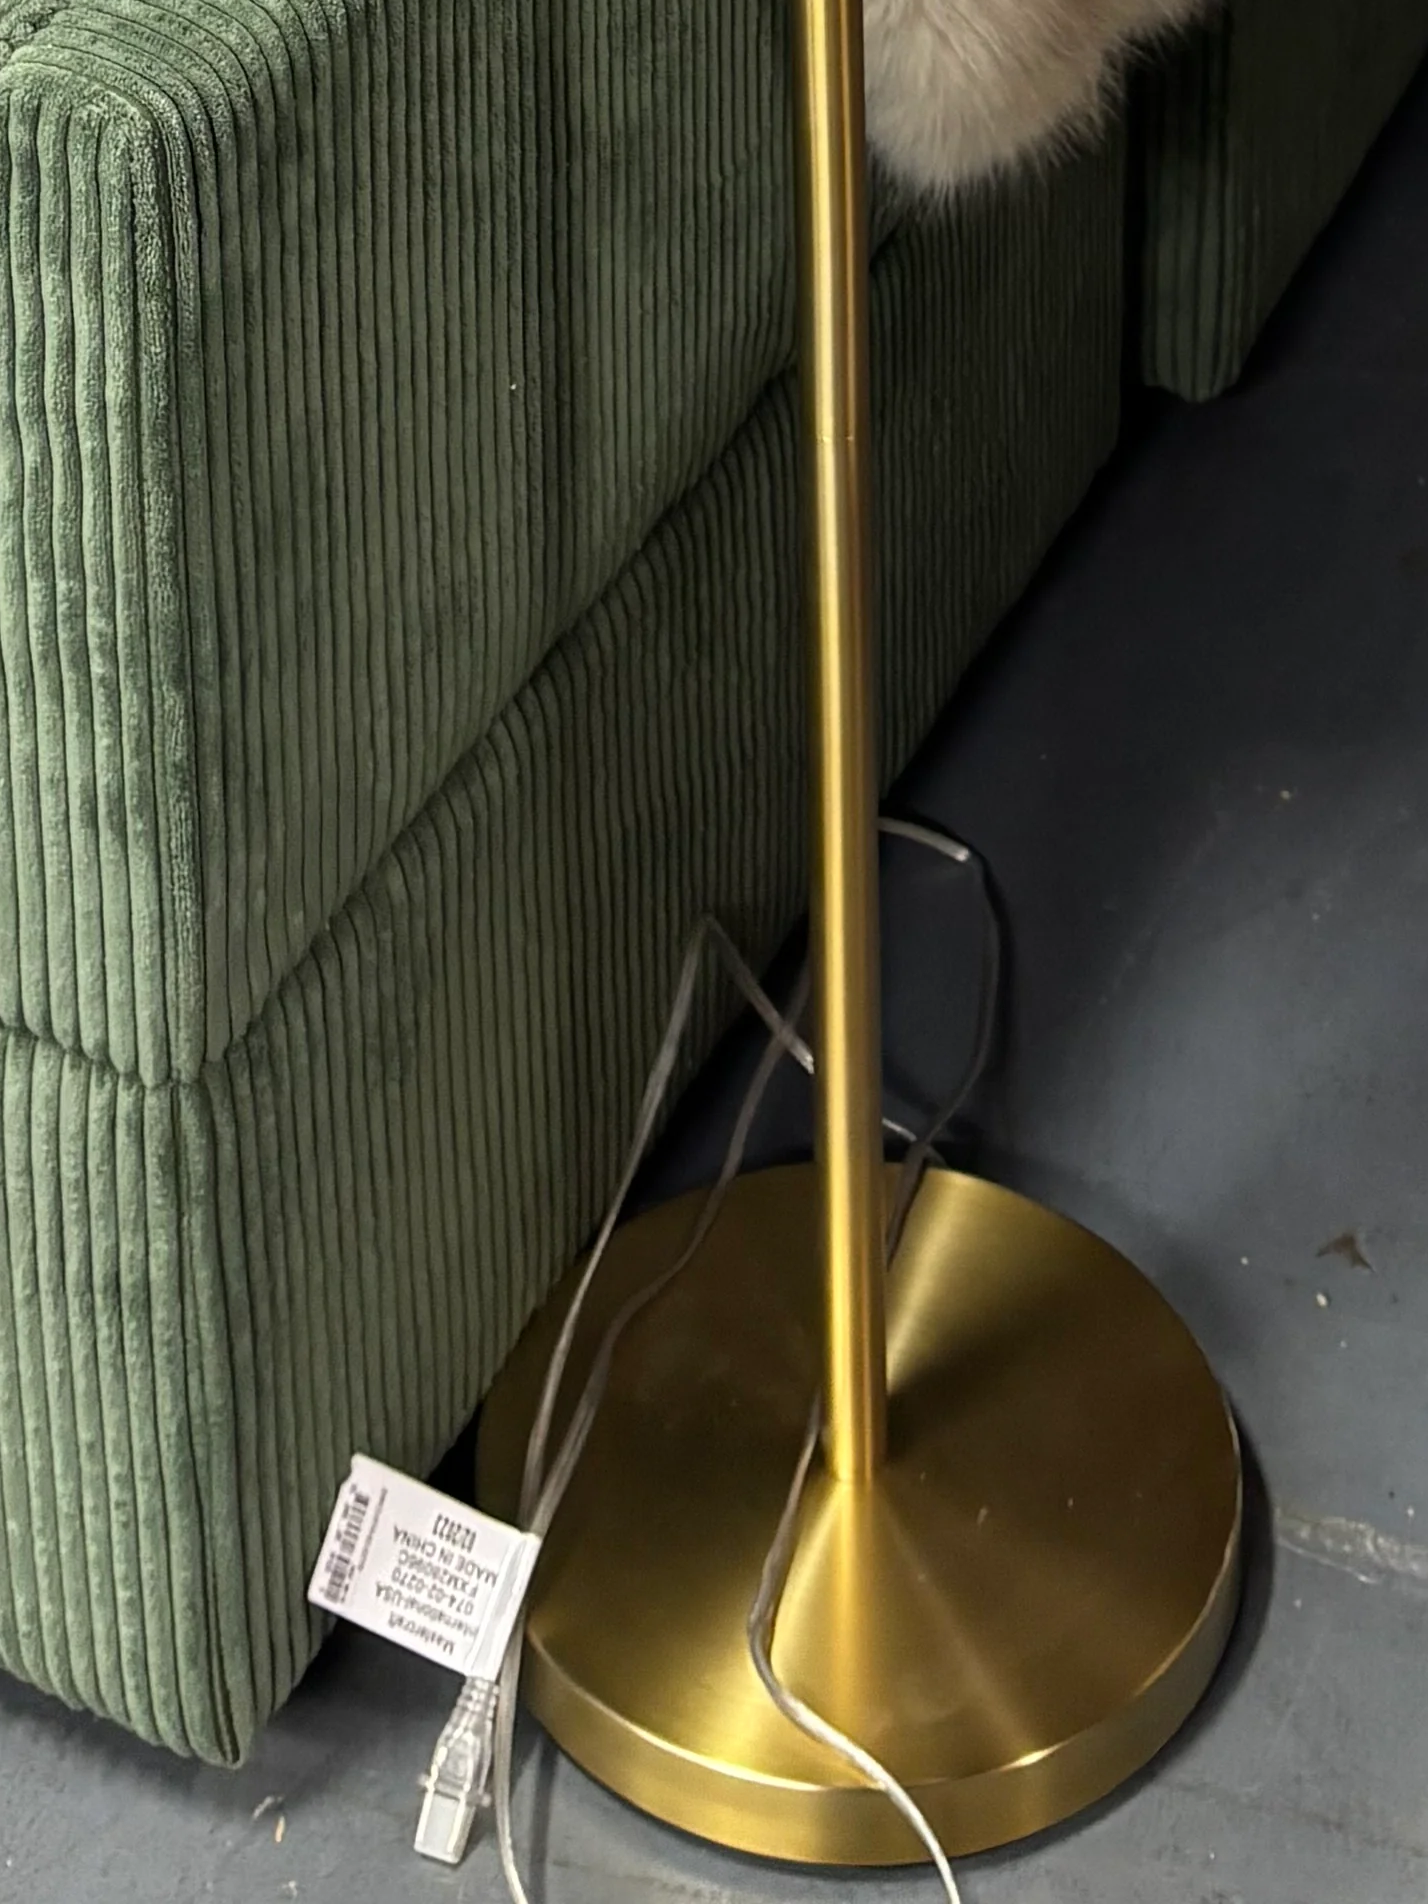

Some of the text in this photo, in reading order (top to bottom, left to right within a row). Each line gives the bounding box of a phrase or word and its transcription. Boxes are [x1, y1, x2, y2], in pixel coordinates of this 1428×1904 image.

[394, 1525, 498, 1588] MADE IN CHINA
